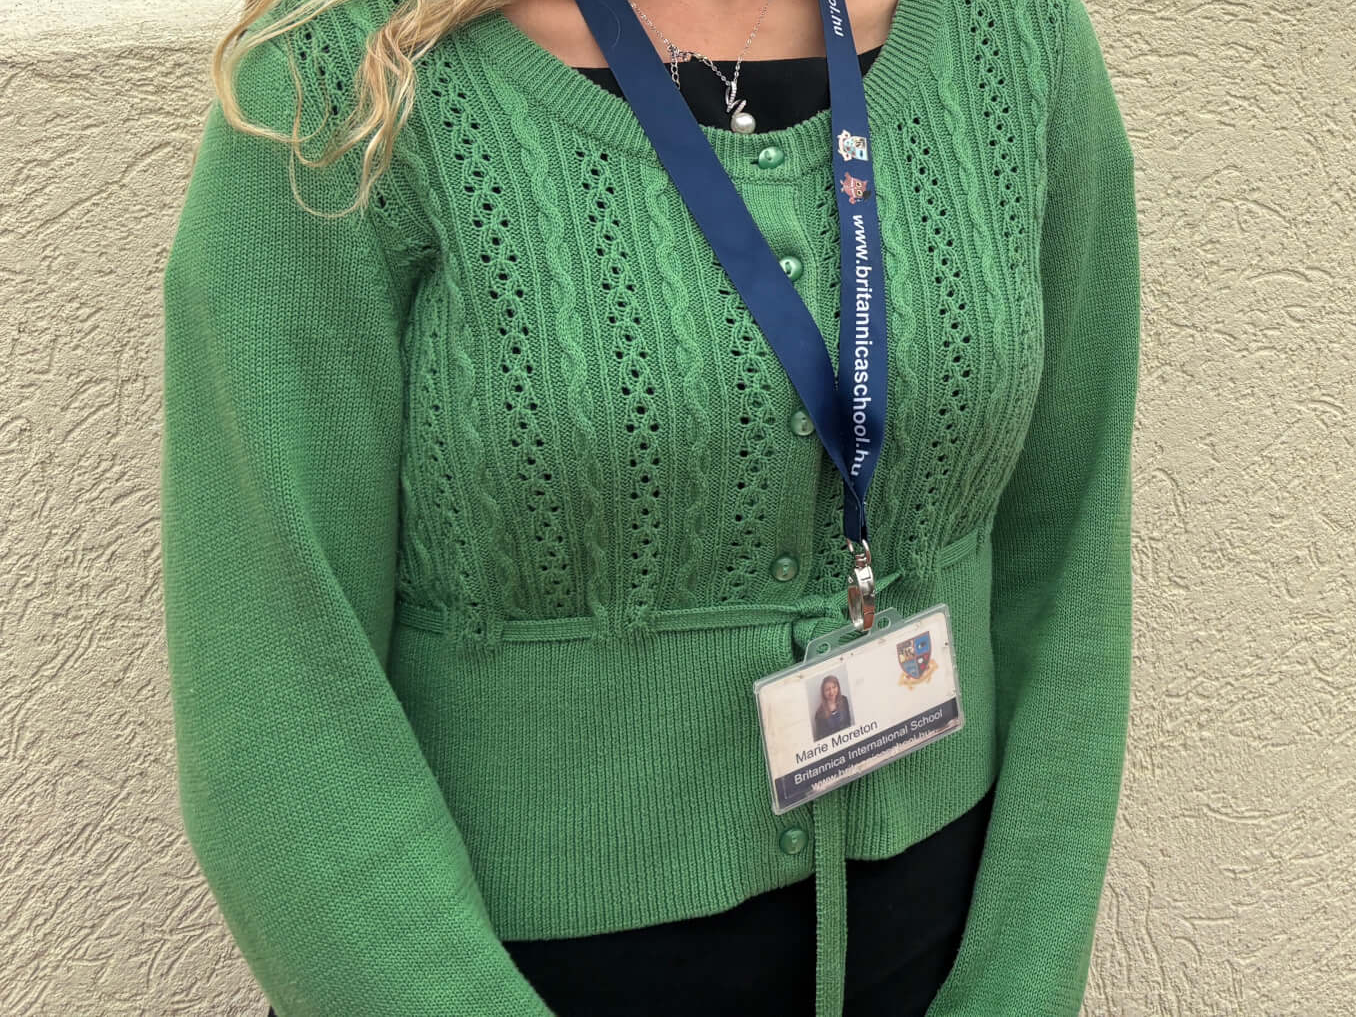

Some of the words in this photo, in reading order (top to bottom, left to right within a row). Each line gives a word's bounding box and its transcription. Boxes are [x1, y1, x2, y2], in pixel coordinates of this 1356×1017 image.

[851, 214, 873, 477] www.britannicaschool.hu
[794, 755, 846, 785] Britannica
[848, 725, 908, 760] International
[910, 709, 943, 731] School
[795, 742, 829, 764] Marie
[831, 719, 878, 750] Moreton
